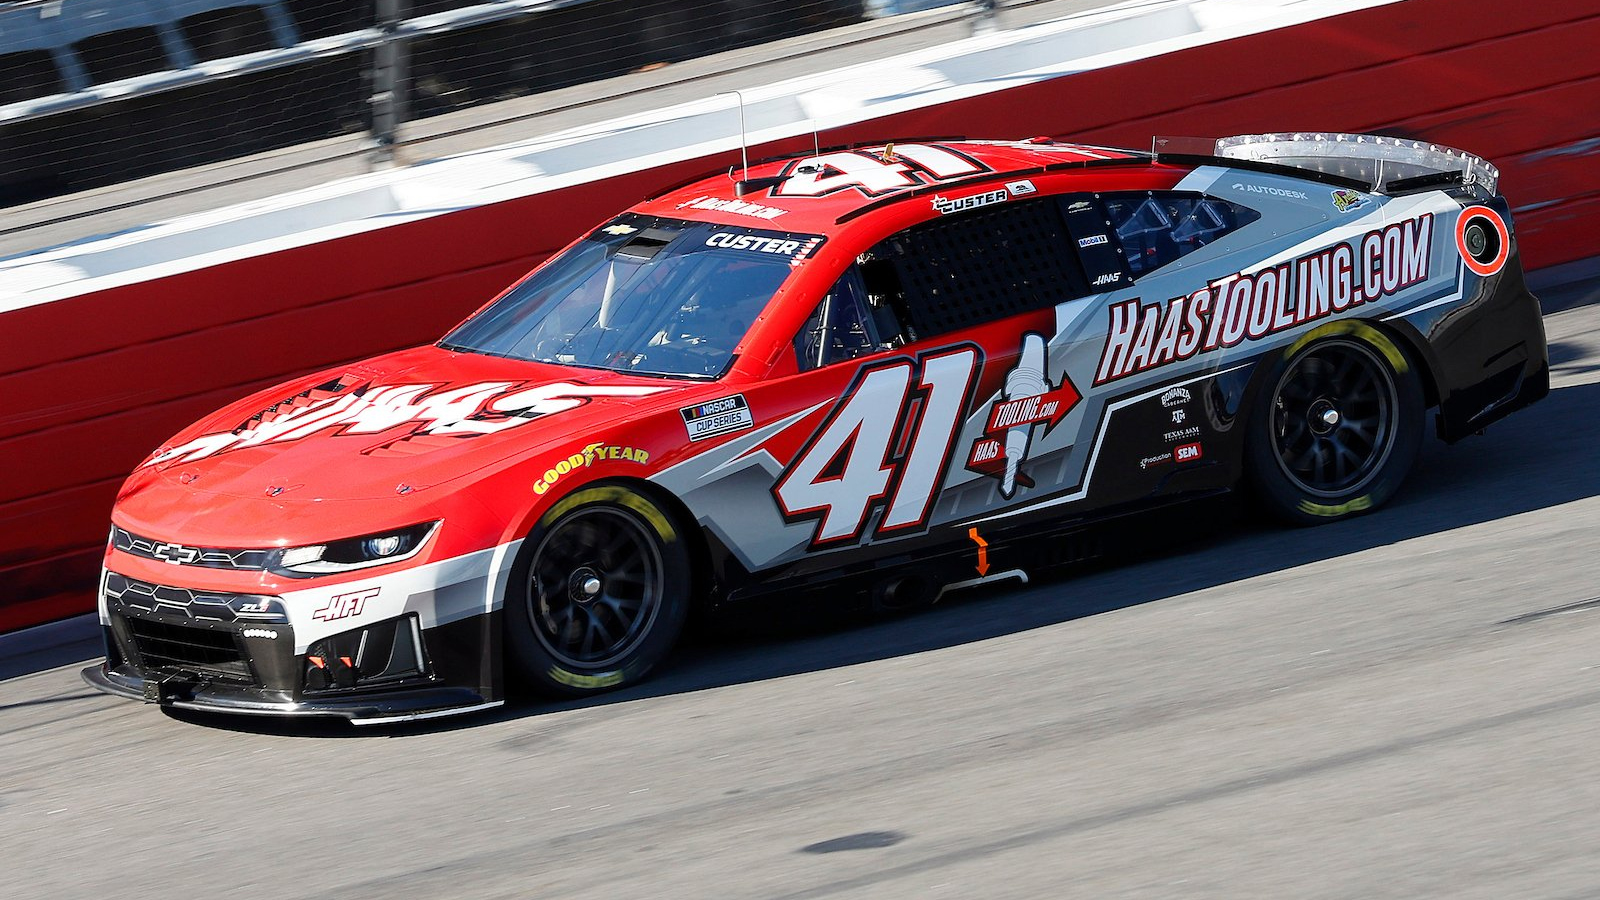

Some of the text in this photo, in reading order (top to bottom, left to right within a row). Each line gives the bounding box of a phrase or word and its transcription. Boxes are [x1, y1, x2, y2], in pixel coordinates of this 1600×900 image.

[772, 141, 990, 199] 41
[935, 190, 1006, 213] CUSTER
[1246, 184, 1309, 200] AUTODESK
[705, 232, 799, 255] CUSTER
[1092, 272, 1121, 286] HAAS
[1096, 212, 1434, 385] HAASTOOLING.COM
[702, 398, 737, 415] NASCAR
[1161, 387, 1191, 405] BONANZA
[696, 412, 742, 432] CUP SERIES
[993, 396, 1060, 429] TOOLING.COM
[772, 344, 980, 547] 41
[1163, 430, 1184, 440] TEXAS
[973, 440, 1000, 463] HAAS
[1177, 446, 1198, 459] SEM
[312, 586, 382, 623] HFT
